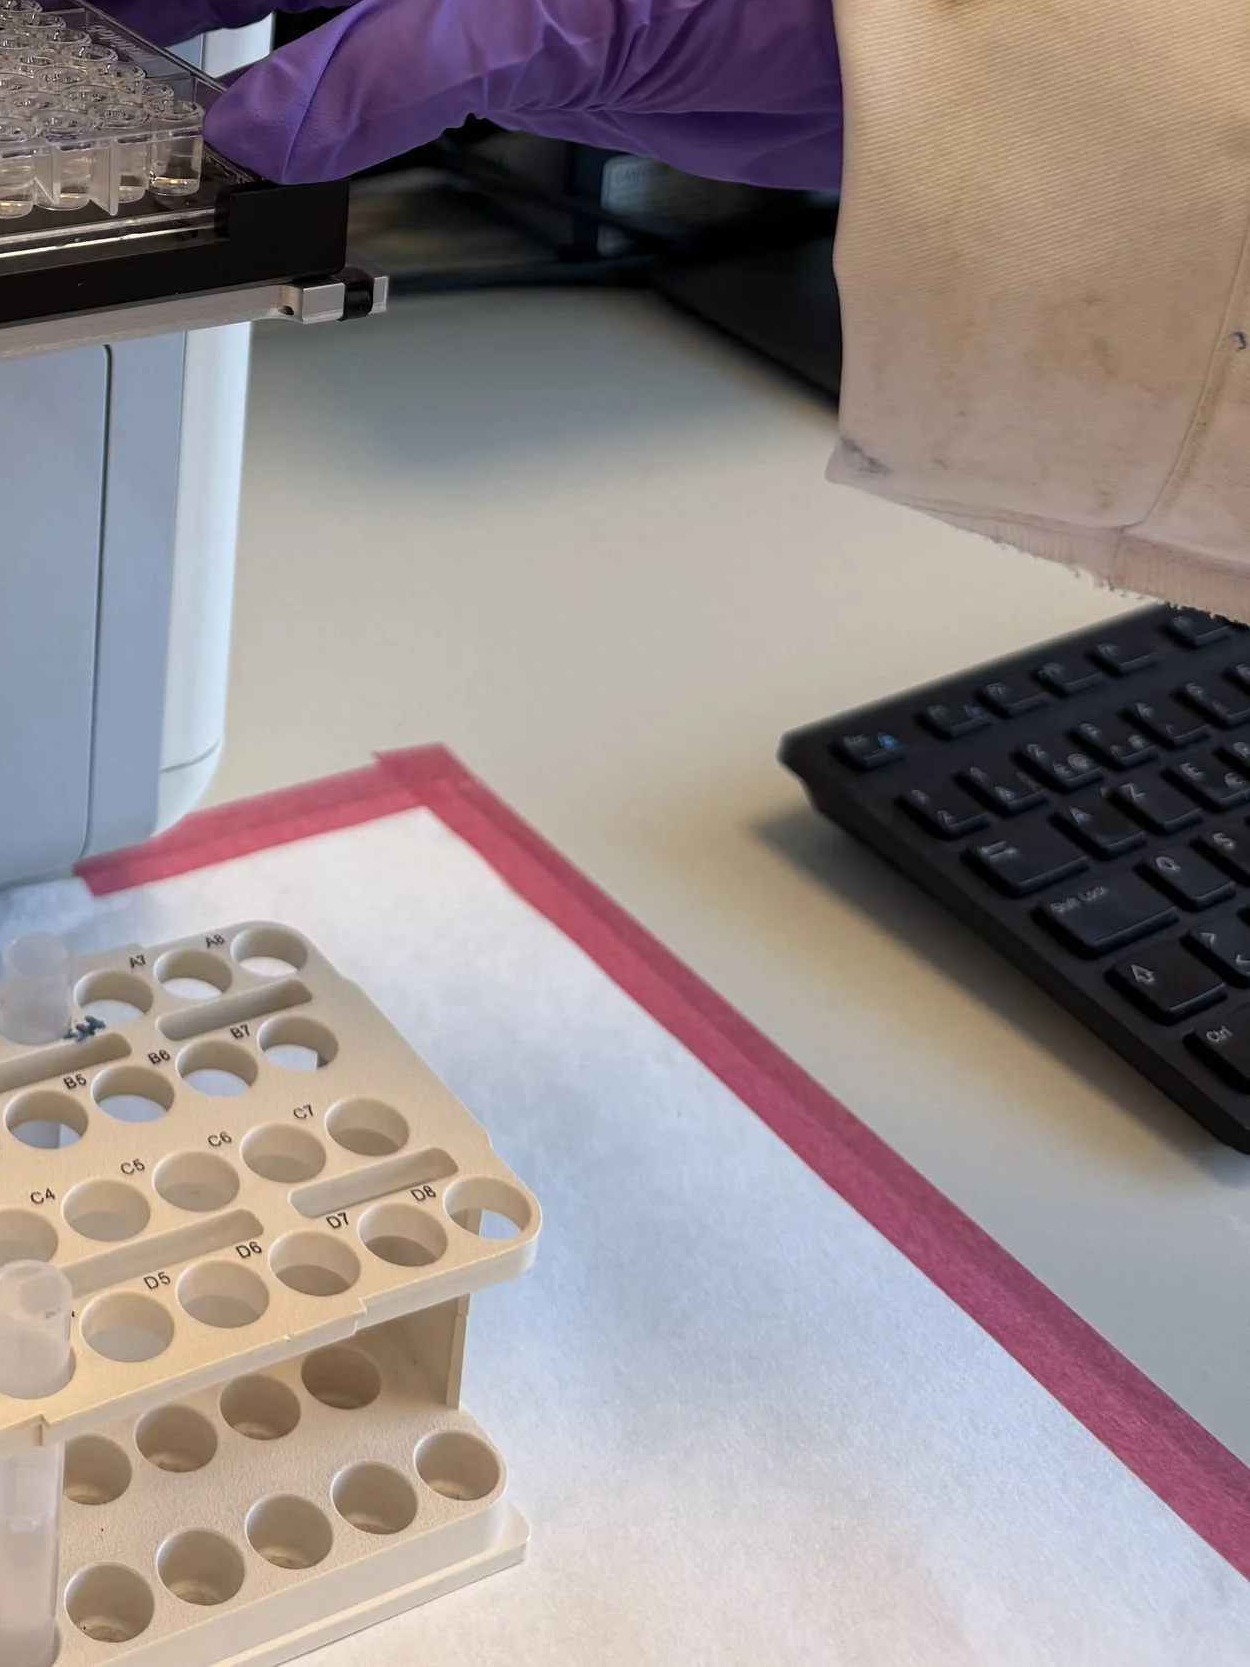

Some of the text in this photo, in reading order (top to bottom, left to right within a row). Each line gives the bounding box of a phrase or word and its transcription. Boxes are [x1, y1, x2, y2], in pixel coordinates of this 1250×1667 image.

[1180, 762, 1204, 781] E
[1069, 806, 1093, 826] A
[129, 954, 147, 969] A7
[1206, 1026, 1233, 1043] Ctrl
[63, 1073, 87, 1090] B5
[147, 1049, 171, 1065] B6
[229, 1023, 251, 1039] B7
[30, 1188, 55, 1205] C4
[120, 1158, 145, 1175] C5
[207, 1131, 232, 1148] C6
[293, 1104, 314, 1120] C7
[143, 1271, 171, 1292] D5
[235, 1240, 262, 1260] D6
[326, 1211, 350, 1230] D7
[410, 1185, 436, 1203] D8
